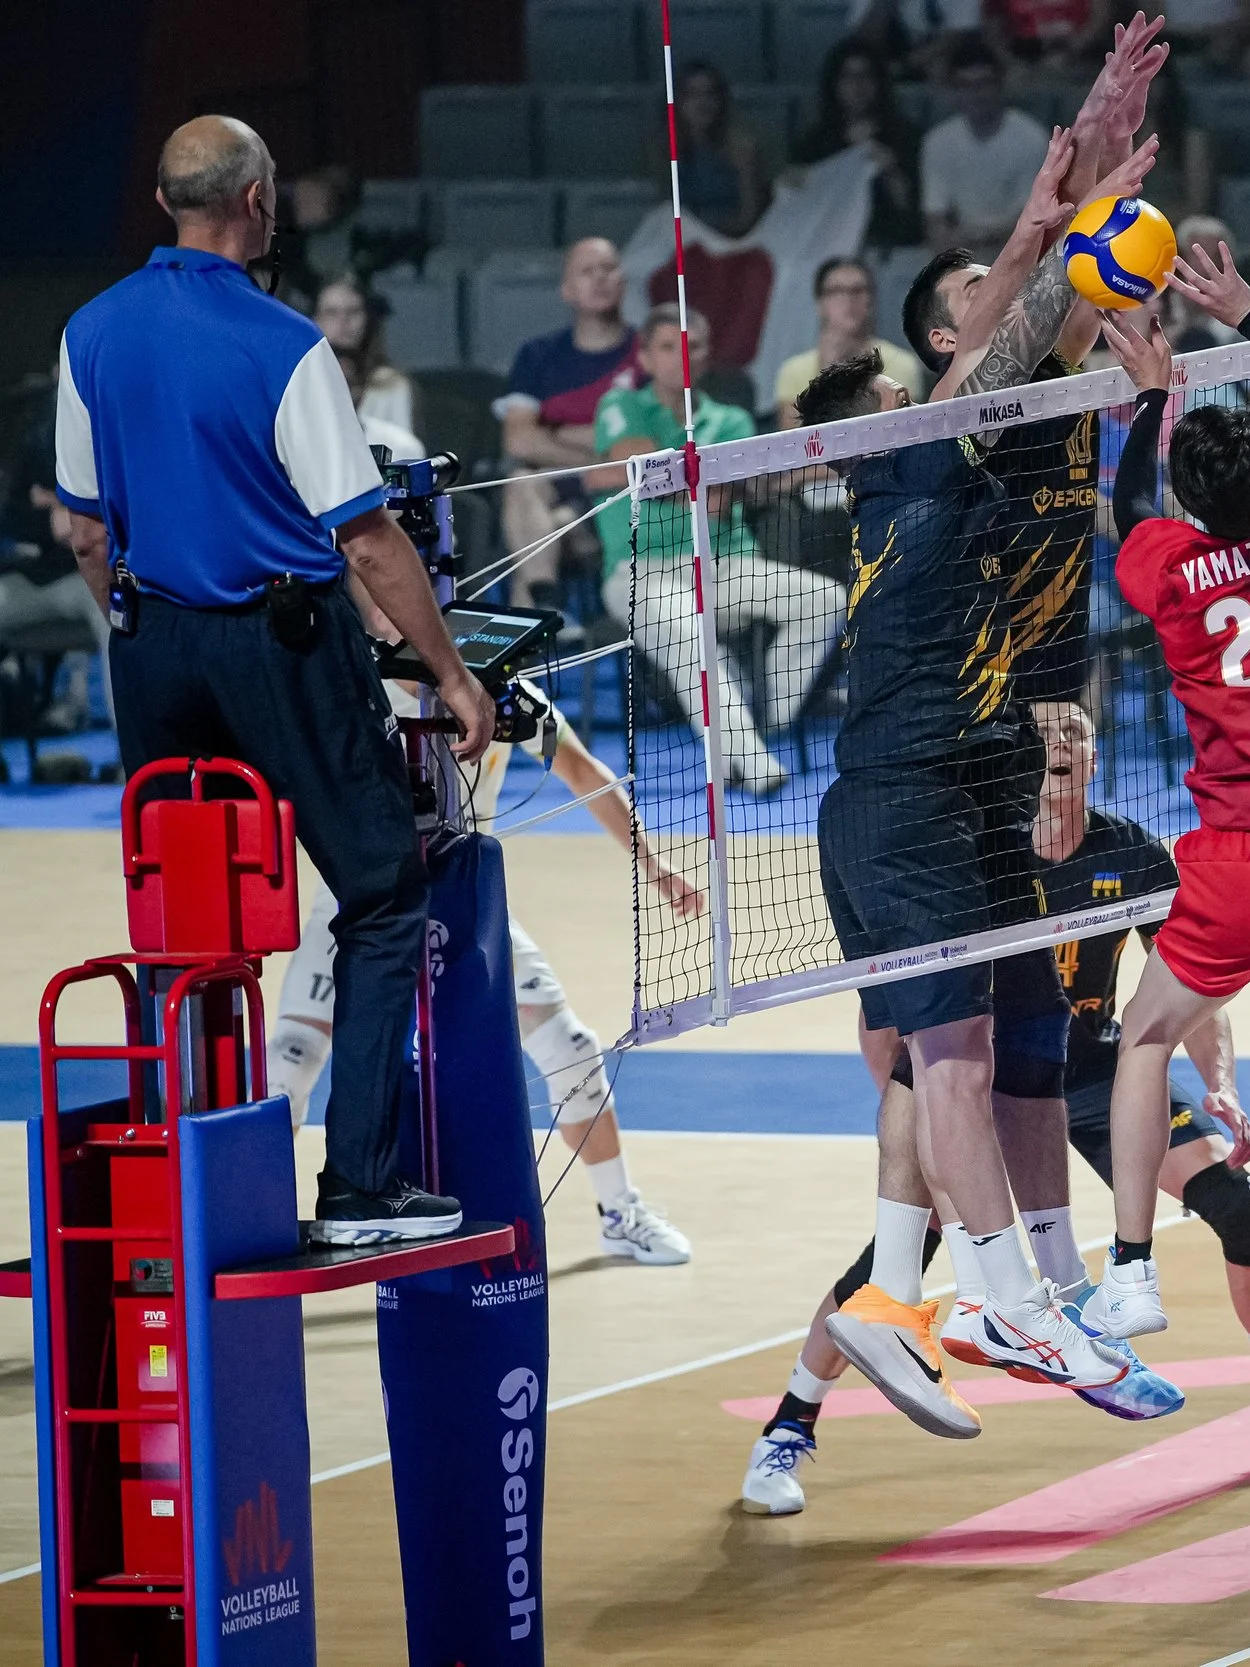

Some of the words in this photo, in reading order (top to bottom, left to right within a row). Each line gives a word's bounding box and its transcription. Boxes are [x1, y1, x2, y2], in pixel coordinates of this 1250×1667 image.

[979, 400, 1024, 425] MIKASA
[469, 633, 514, 646] STANDBY
[880, 954, 925, 972] VOLLEYBALL
[1030, 1221, 1056, 1233] 4F
[471, 1273, 544, 1297] VOLLEYBALL
[472, 1295, 517, 1307] NATIONS
[519, 1288, 545, 1301] LEAGUE
[501, 1427, 537, 1640] Senoh
[221, 1577, 299, 1617] VOLLEYBALL
[222, 1611, 262, 1636] NATIONS
[265, 1600, 300, 1622] LEAGUE
